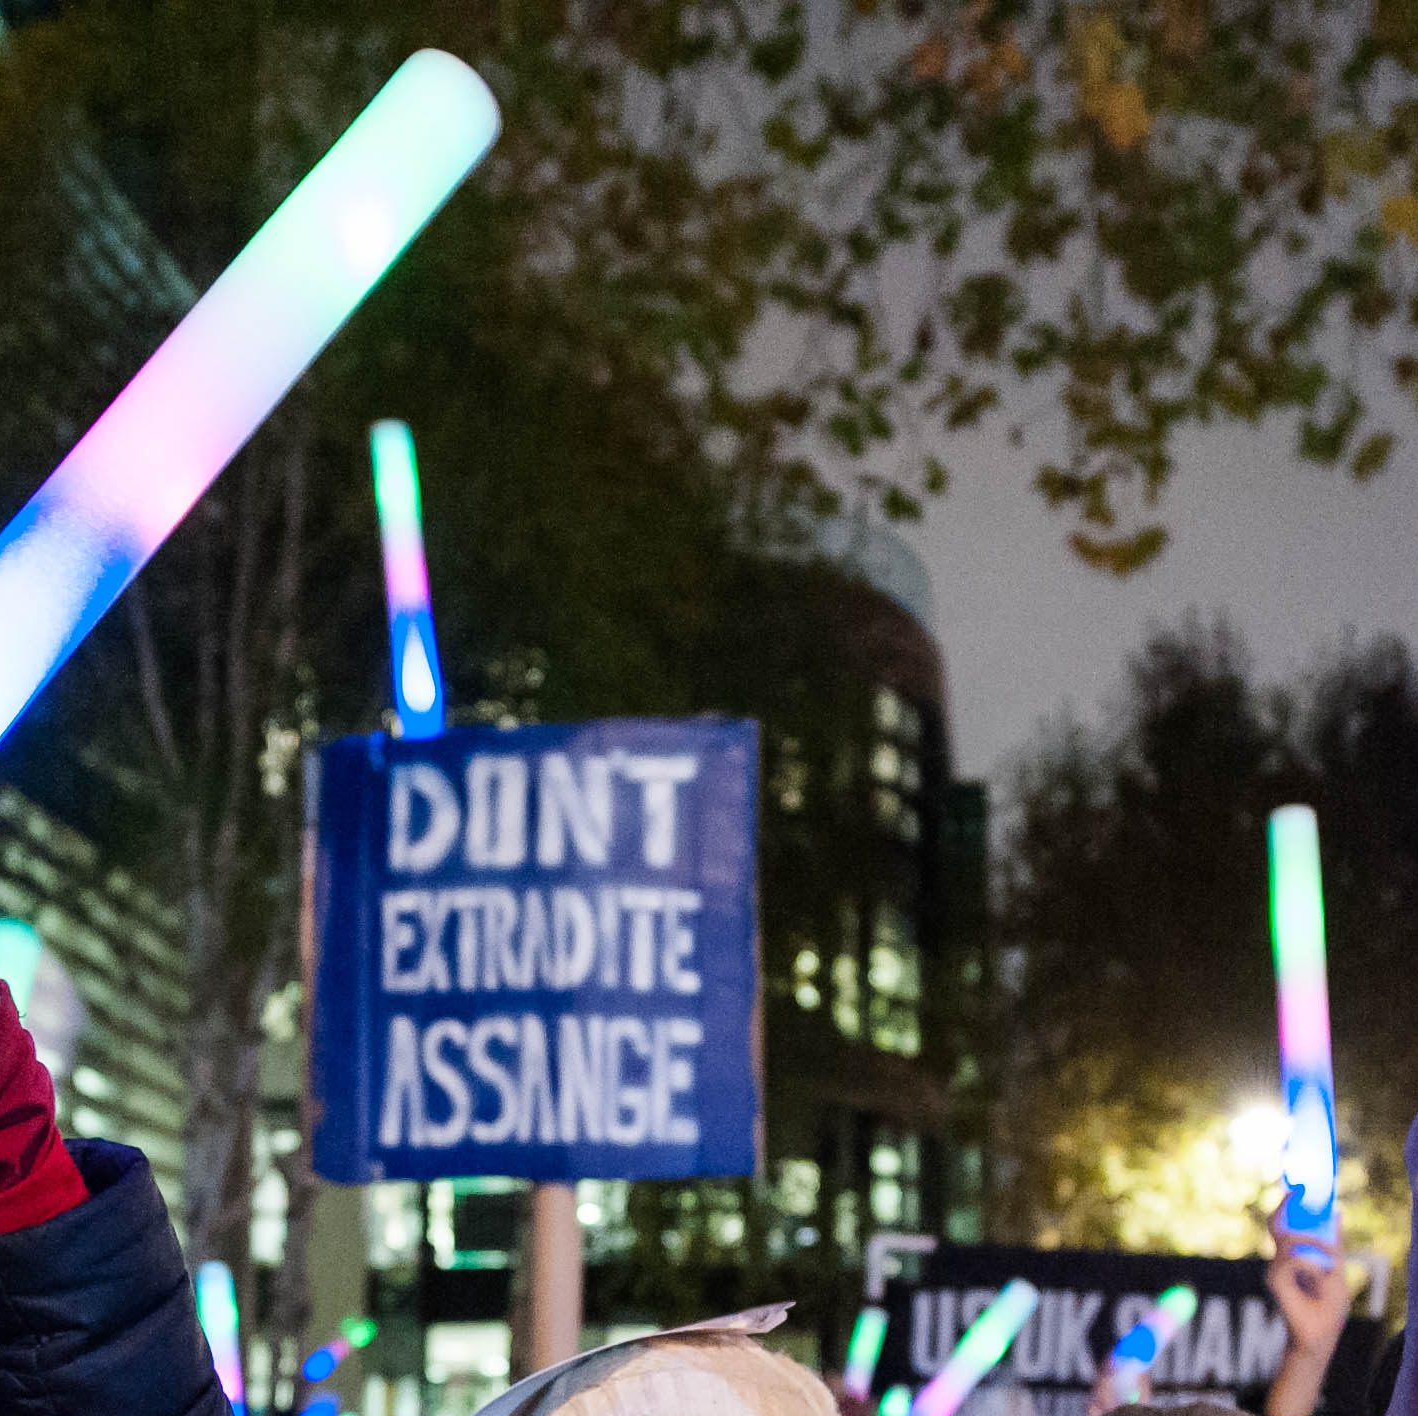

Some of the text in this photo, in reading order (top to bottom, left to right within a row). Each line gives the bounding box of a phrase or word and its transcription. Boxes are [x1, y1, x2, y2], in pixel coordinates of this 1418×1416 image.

[381, 886, 701, 993] EXTRADITE
[381, 1016, 703, 1148] ASSANGE
[1013, 1289, 1103, 1381] UK
